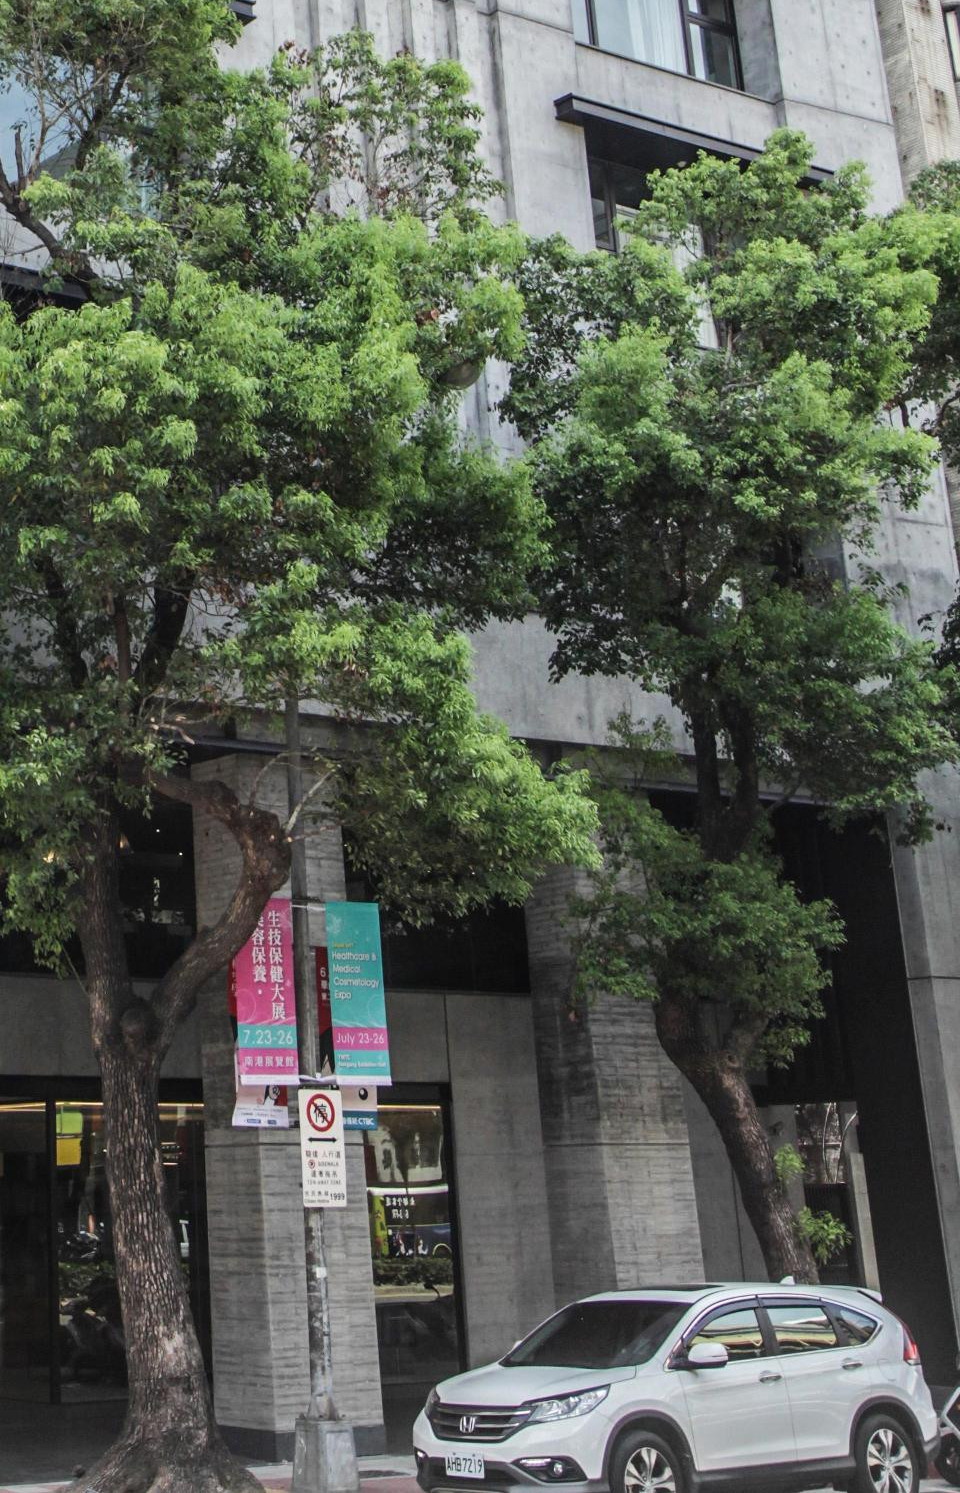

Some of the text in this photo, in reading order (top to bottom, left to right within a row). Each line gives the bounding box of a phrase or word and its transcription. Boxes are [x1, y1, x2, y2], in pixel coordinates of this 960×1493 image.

[332, 951, 369, 961] Healthcare
[268, 910, 286, 1020] 生技保健大展
[333, 963, 361, 973] Medical
[333, 977, 379, 988] Cosmetology
[334, 990, 352, 1000] Expo
[243, 1030, 294, 1045] 7.23-26
[336, 1033, 385, 1045] July 23-26
[244, 1055, 295, 1067] 南港展覽館
[330, 1192, 345, 1201] 1999
